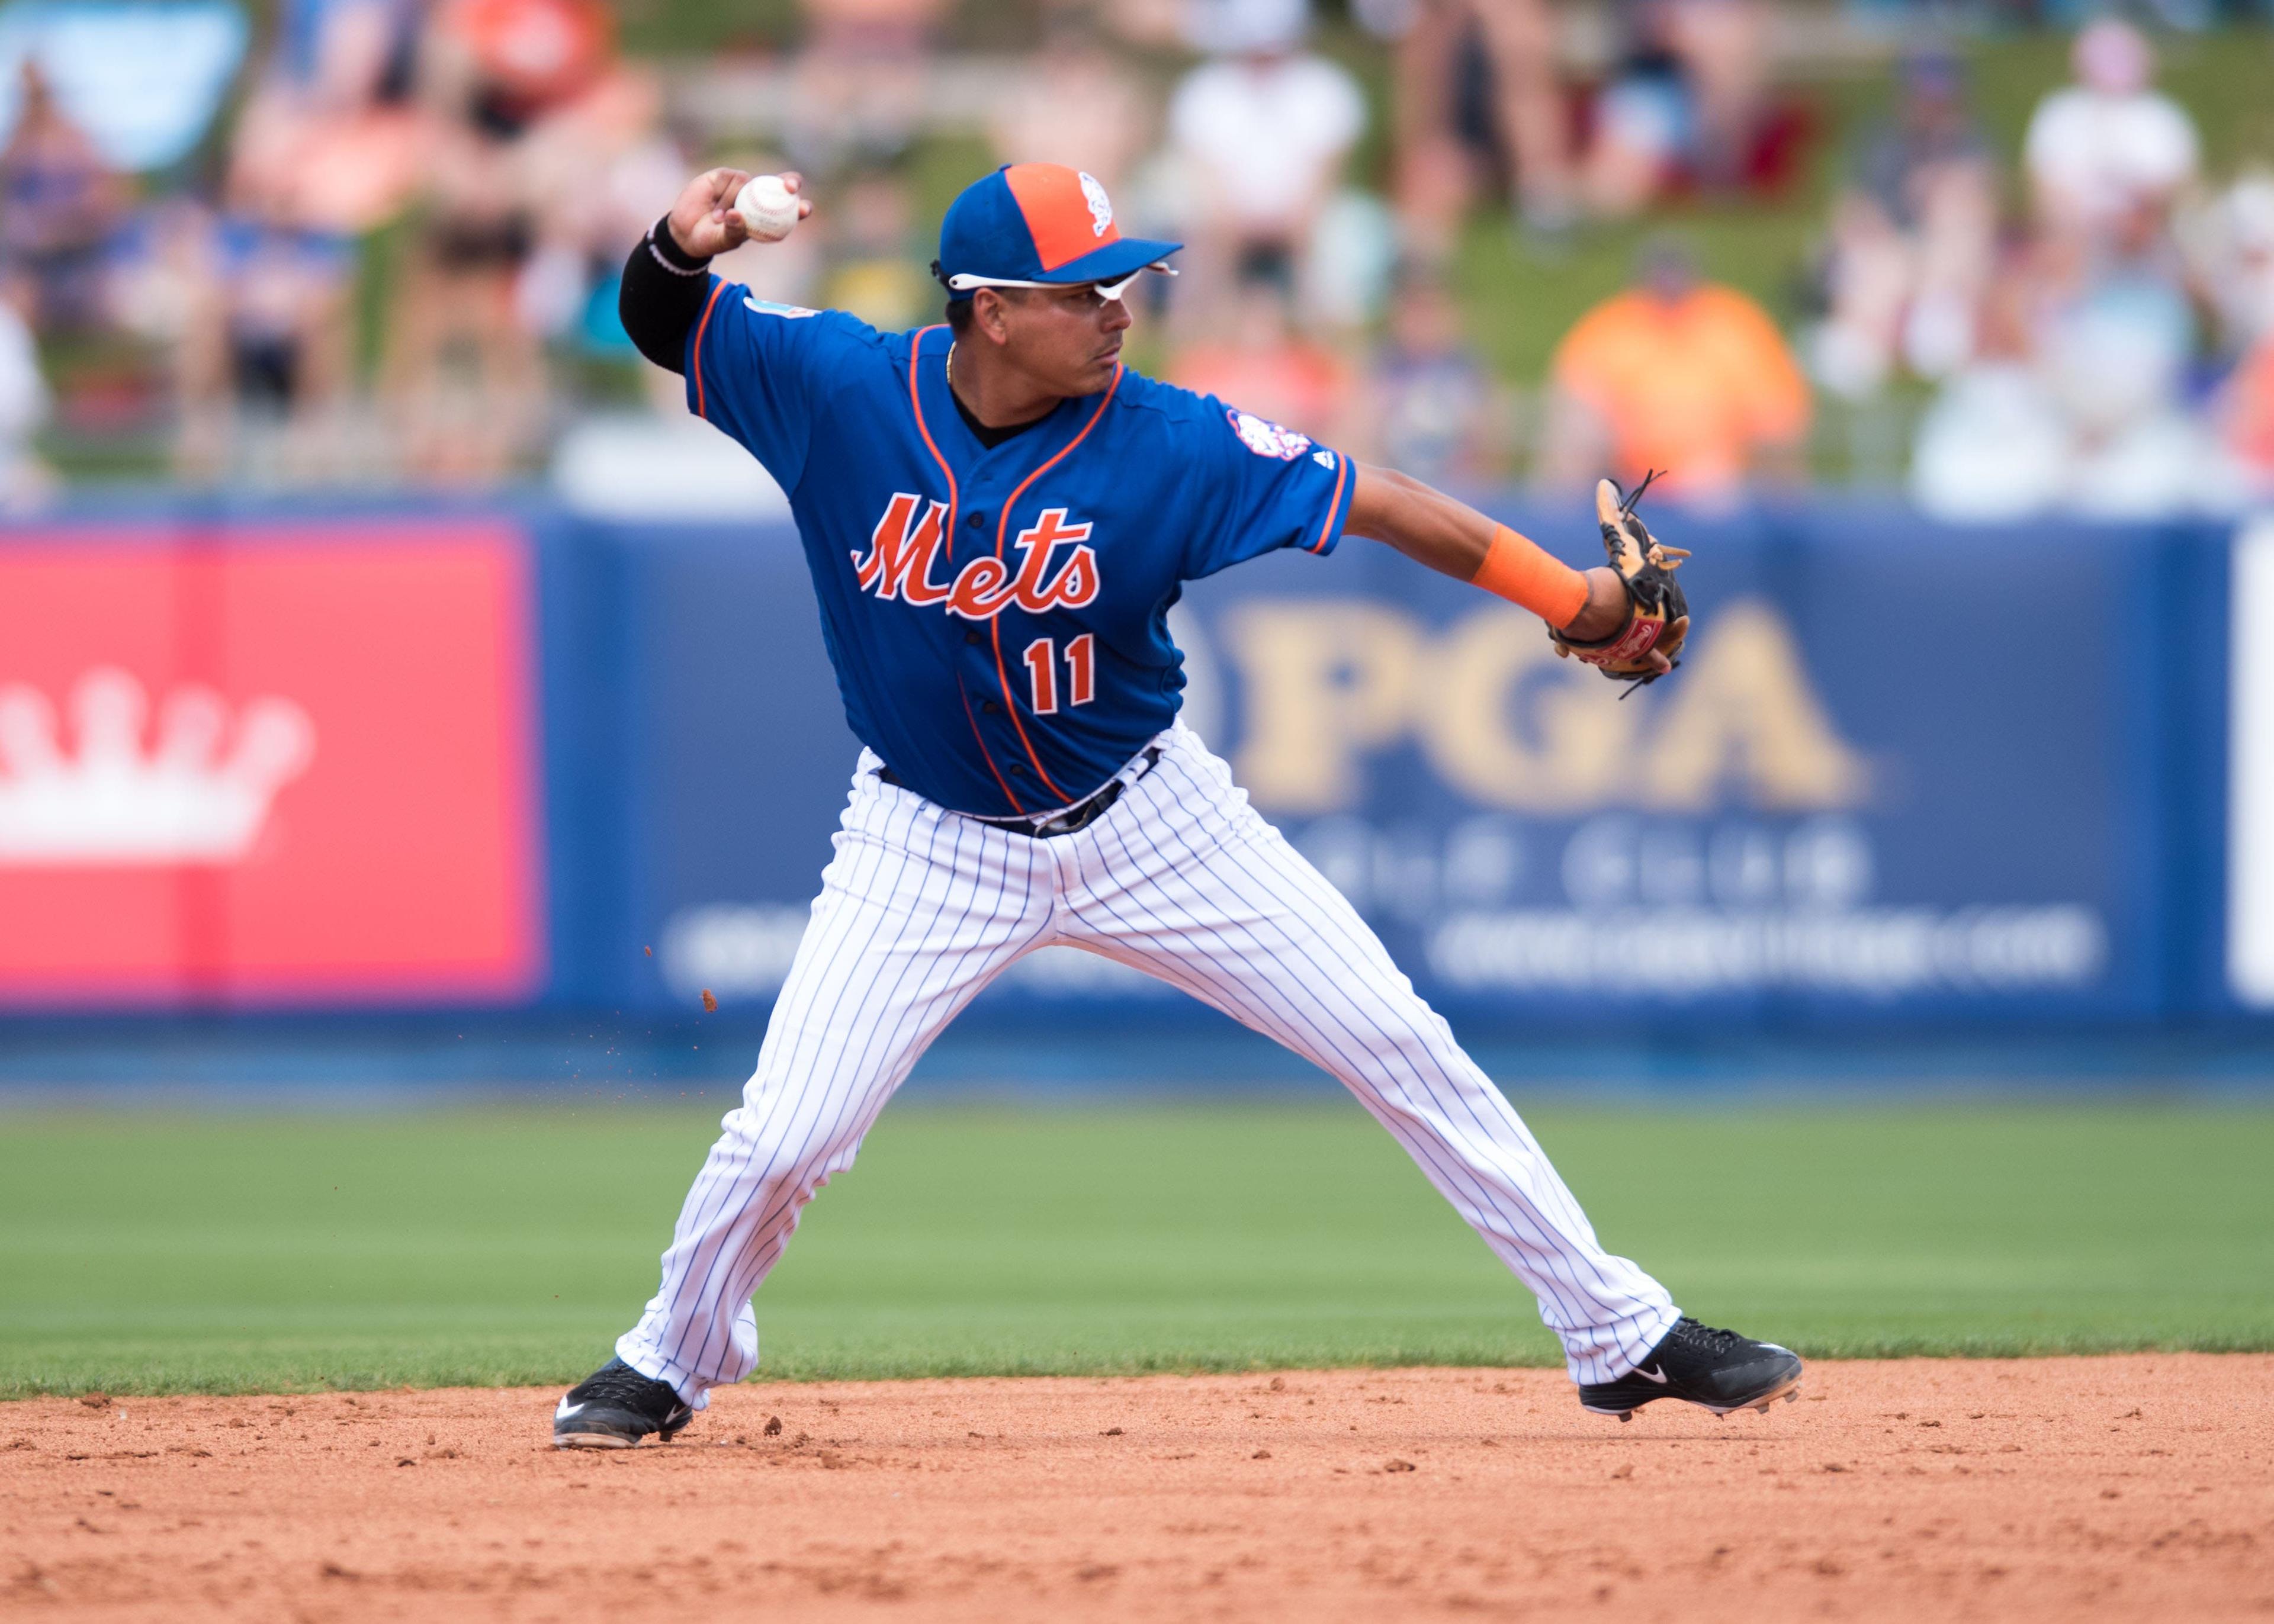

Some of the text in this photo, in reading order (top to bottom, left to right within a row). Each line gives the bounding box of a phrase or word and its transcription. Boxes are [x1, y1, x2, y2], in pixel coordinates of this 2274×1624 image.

[850, 492, 1100, 620] Mets
[1023, 633, 1094, 715] 11
[1229, 601, 1862, 810] PGA
